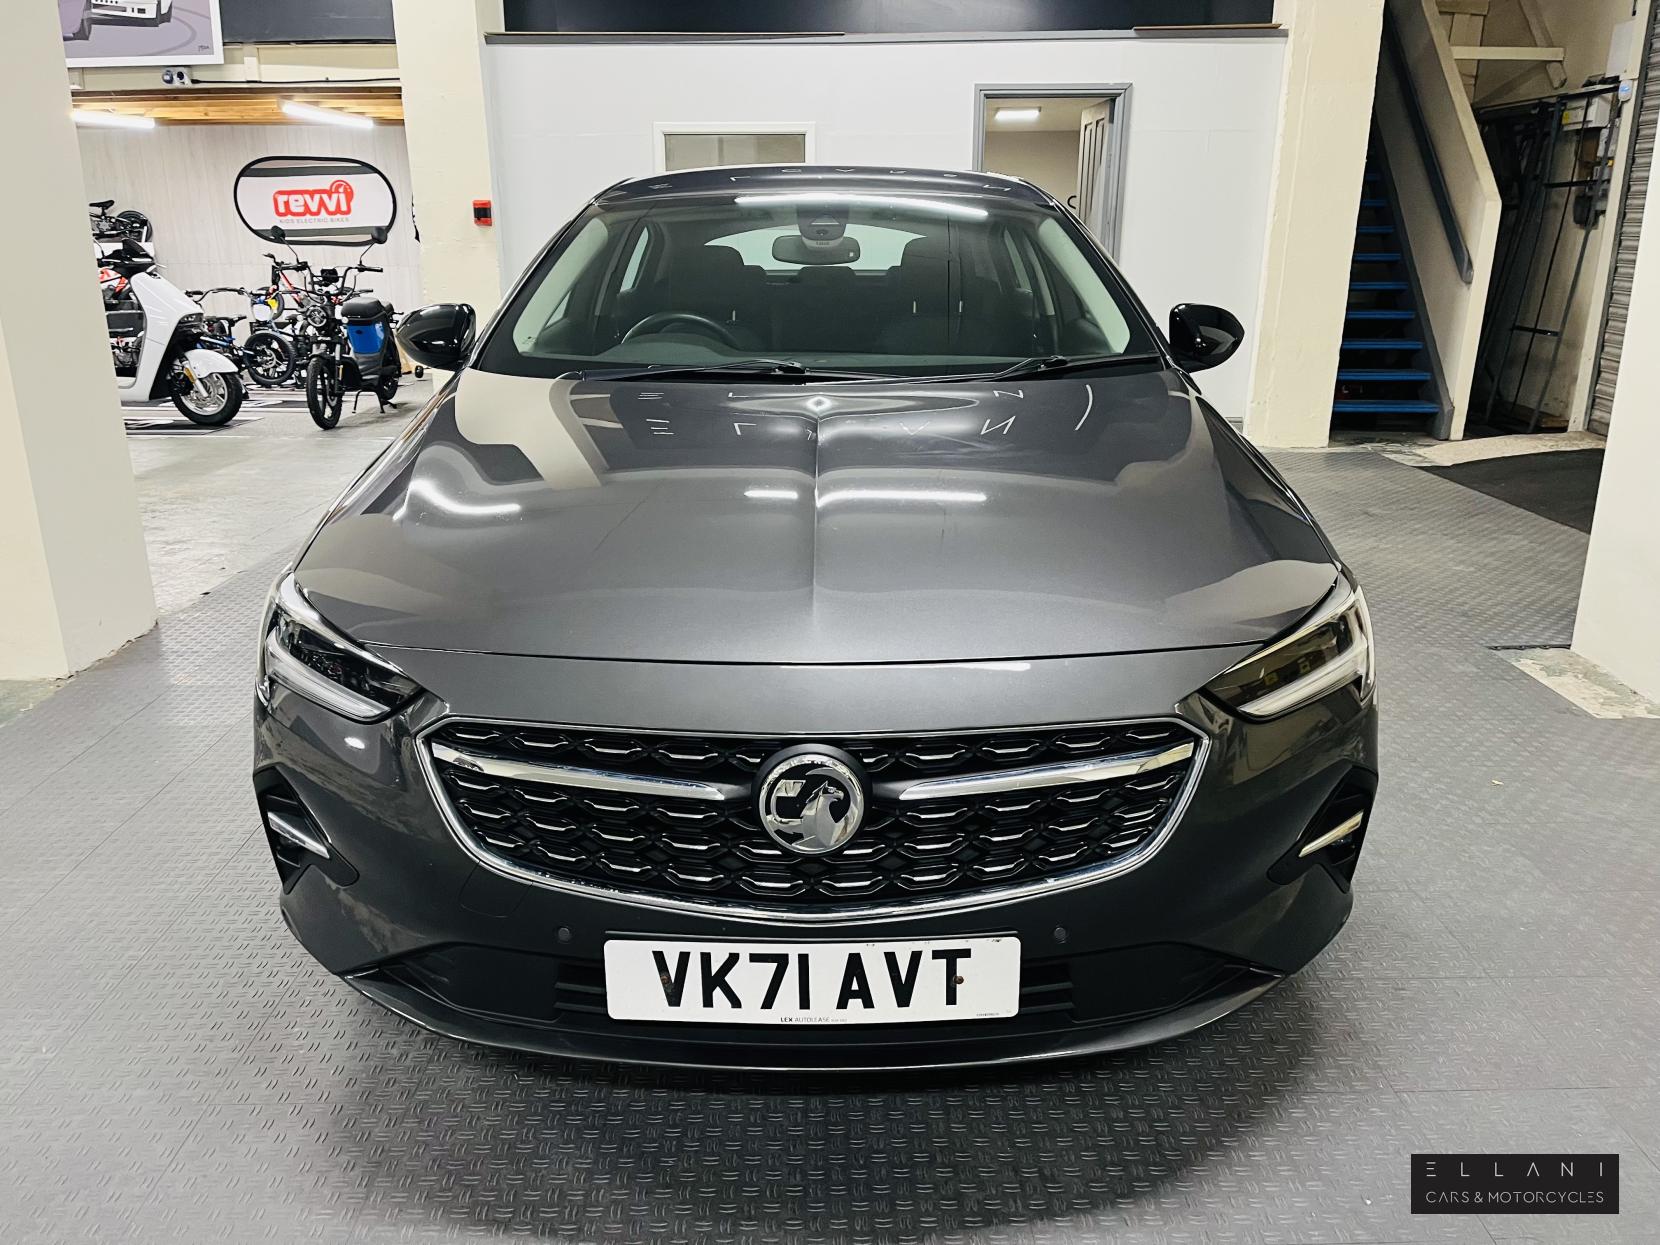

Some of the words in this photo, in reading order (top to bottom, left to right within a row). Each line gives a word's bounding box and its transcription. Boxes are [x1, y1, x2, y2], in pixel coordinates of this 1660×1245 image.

[275, 181, 351, 215] revvi
[652, 950, 811, 1010] VK71
[836, 948, 972, 1010] AVT
